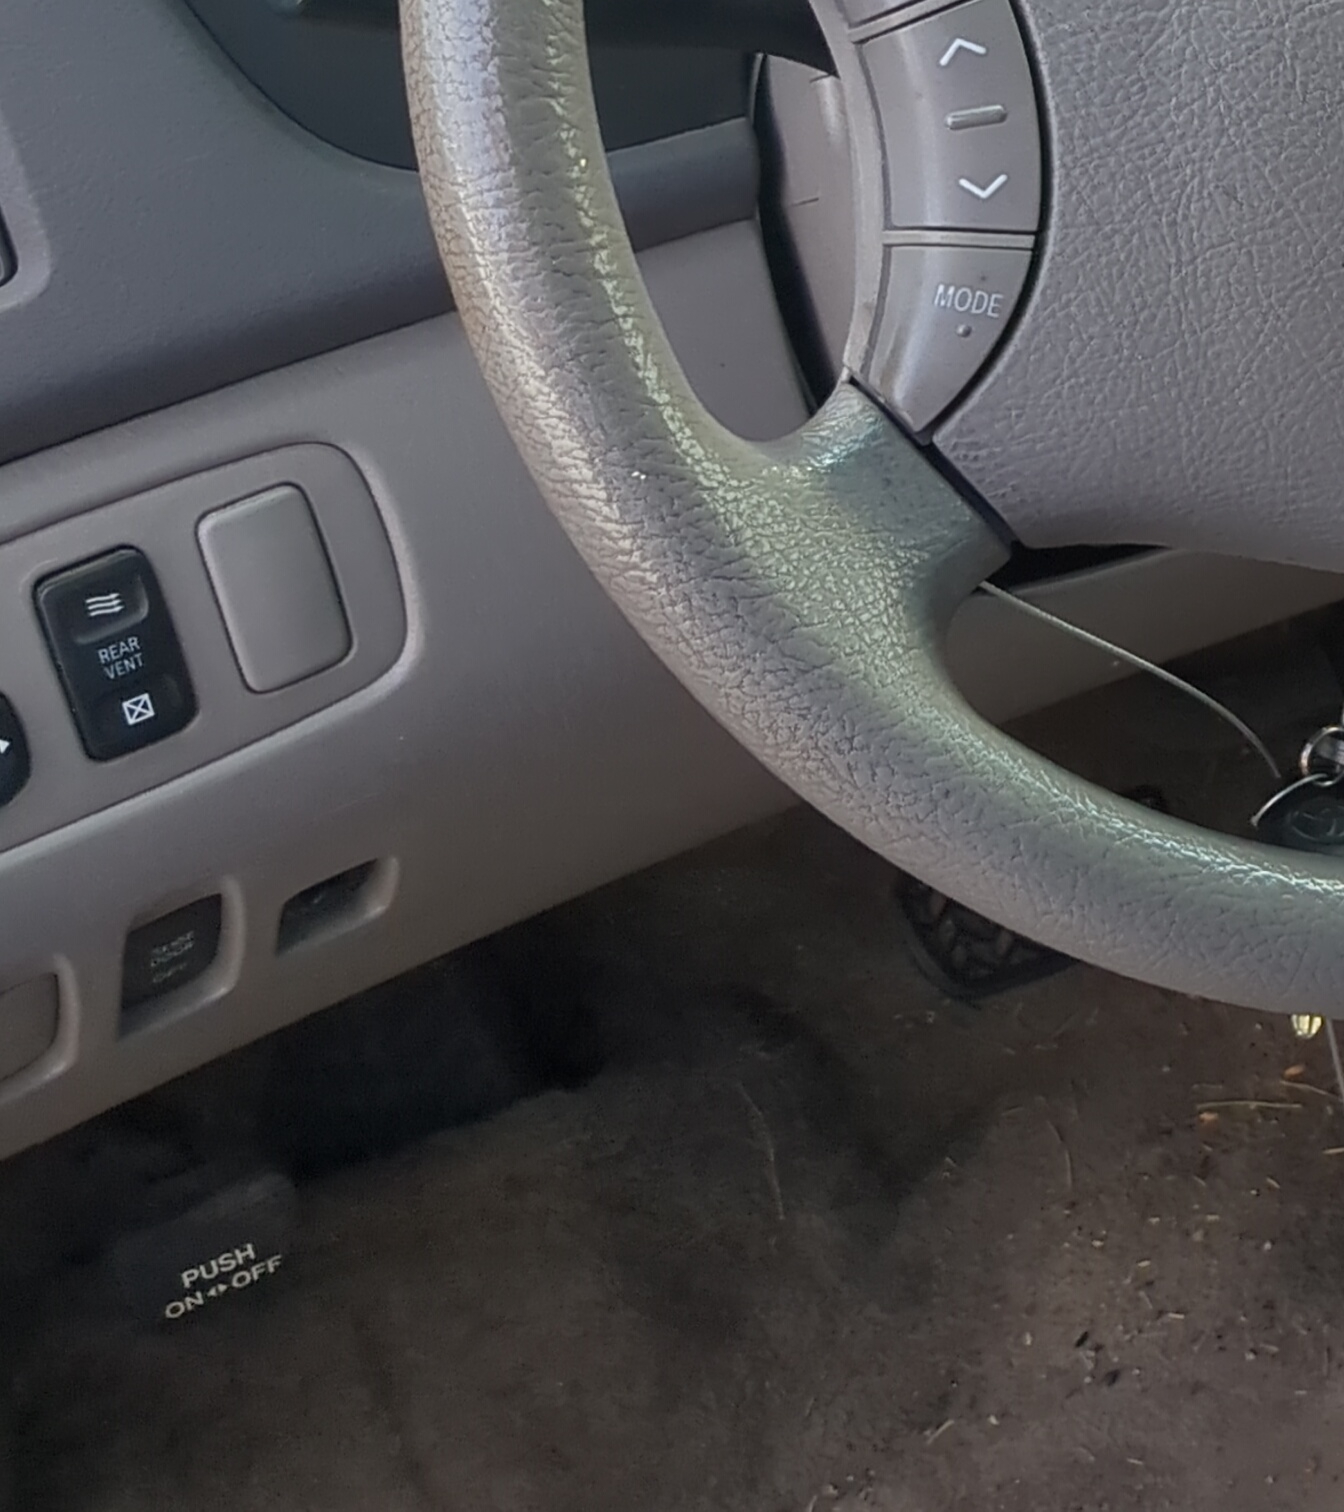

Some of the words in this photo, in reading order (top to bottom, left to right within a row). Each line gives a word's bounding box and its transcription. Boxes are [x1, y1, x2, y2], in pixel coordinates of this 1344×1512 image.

[933, 281, 1003, 319] MODE
[97, 635, 142, 666] REAR
[103, 652, 145, 680] VENT
[180, 1242, 257, 1289] PUSH
[164, 1290, 204, 1319] ON
[231, 1254, 283, 1289] OFF
